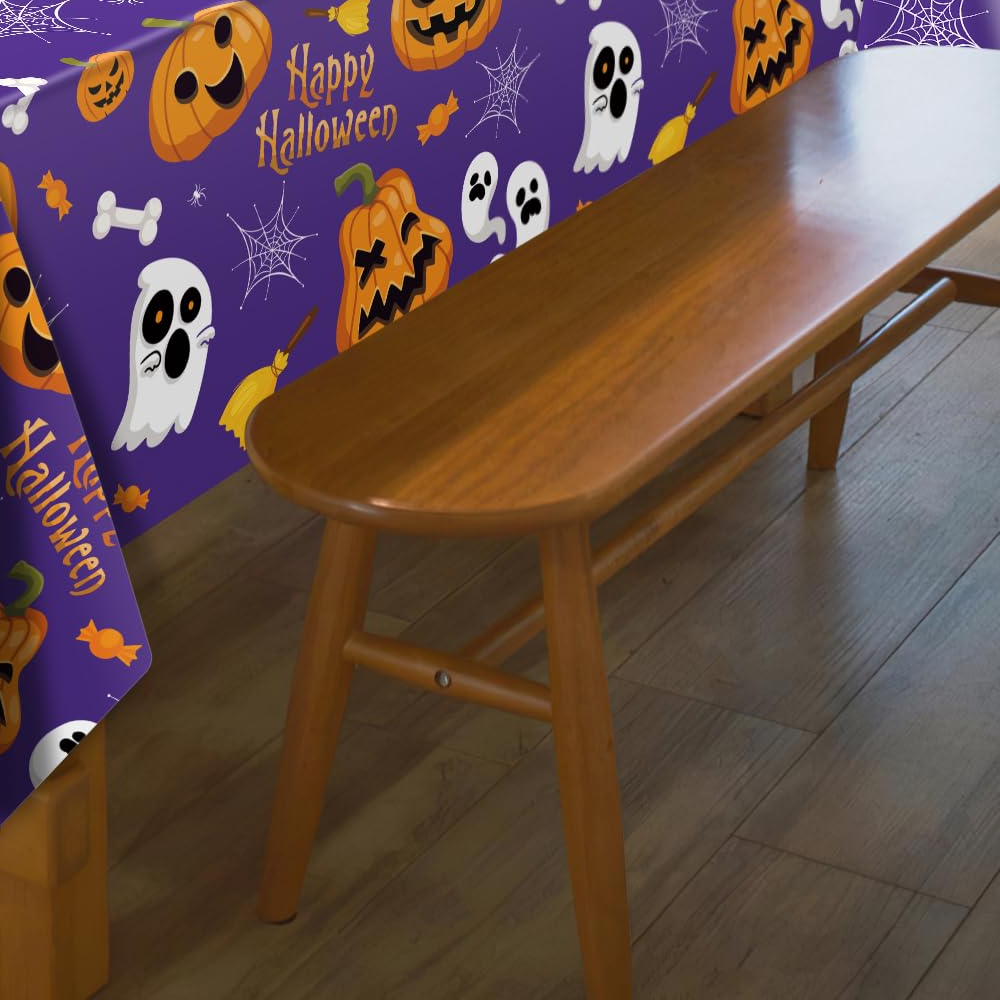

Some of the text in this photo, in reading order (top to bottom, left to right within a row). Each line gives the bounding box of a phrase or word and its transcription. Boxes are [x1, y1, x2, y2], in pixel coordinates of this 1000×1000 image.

[286, 42, 375, 109] Happy
[255, 104, 398, 175] Halloween
[0, 417, 107, 597] Halloween
